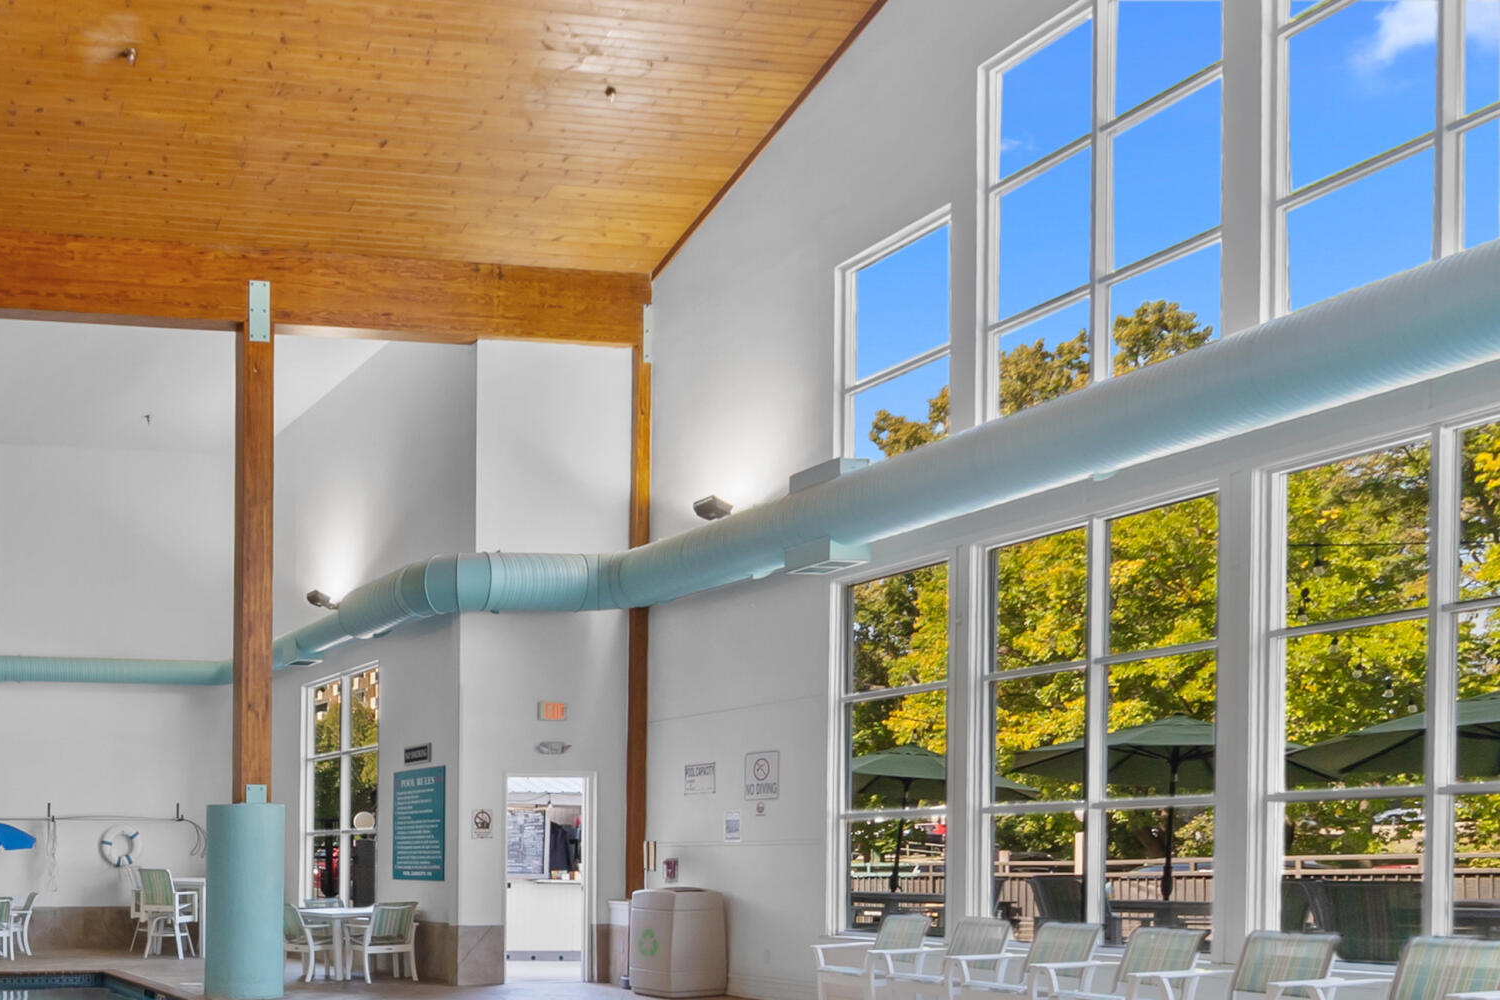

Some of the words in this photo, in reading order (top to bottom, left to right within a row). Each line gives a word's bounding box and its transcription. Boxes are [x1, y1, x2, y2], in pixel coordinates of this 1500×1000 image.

[545, 703, 564, 720] EXIT
[416, 776, 435, 786] RULES
[747, 784, 755, 796] NO
[756, 782, 778, 794] DIVING
